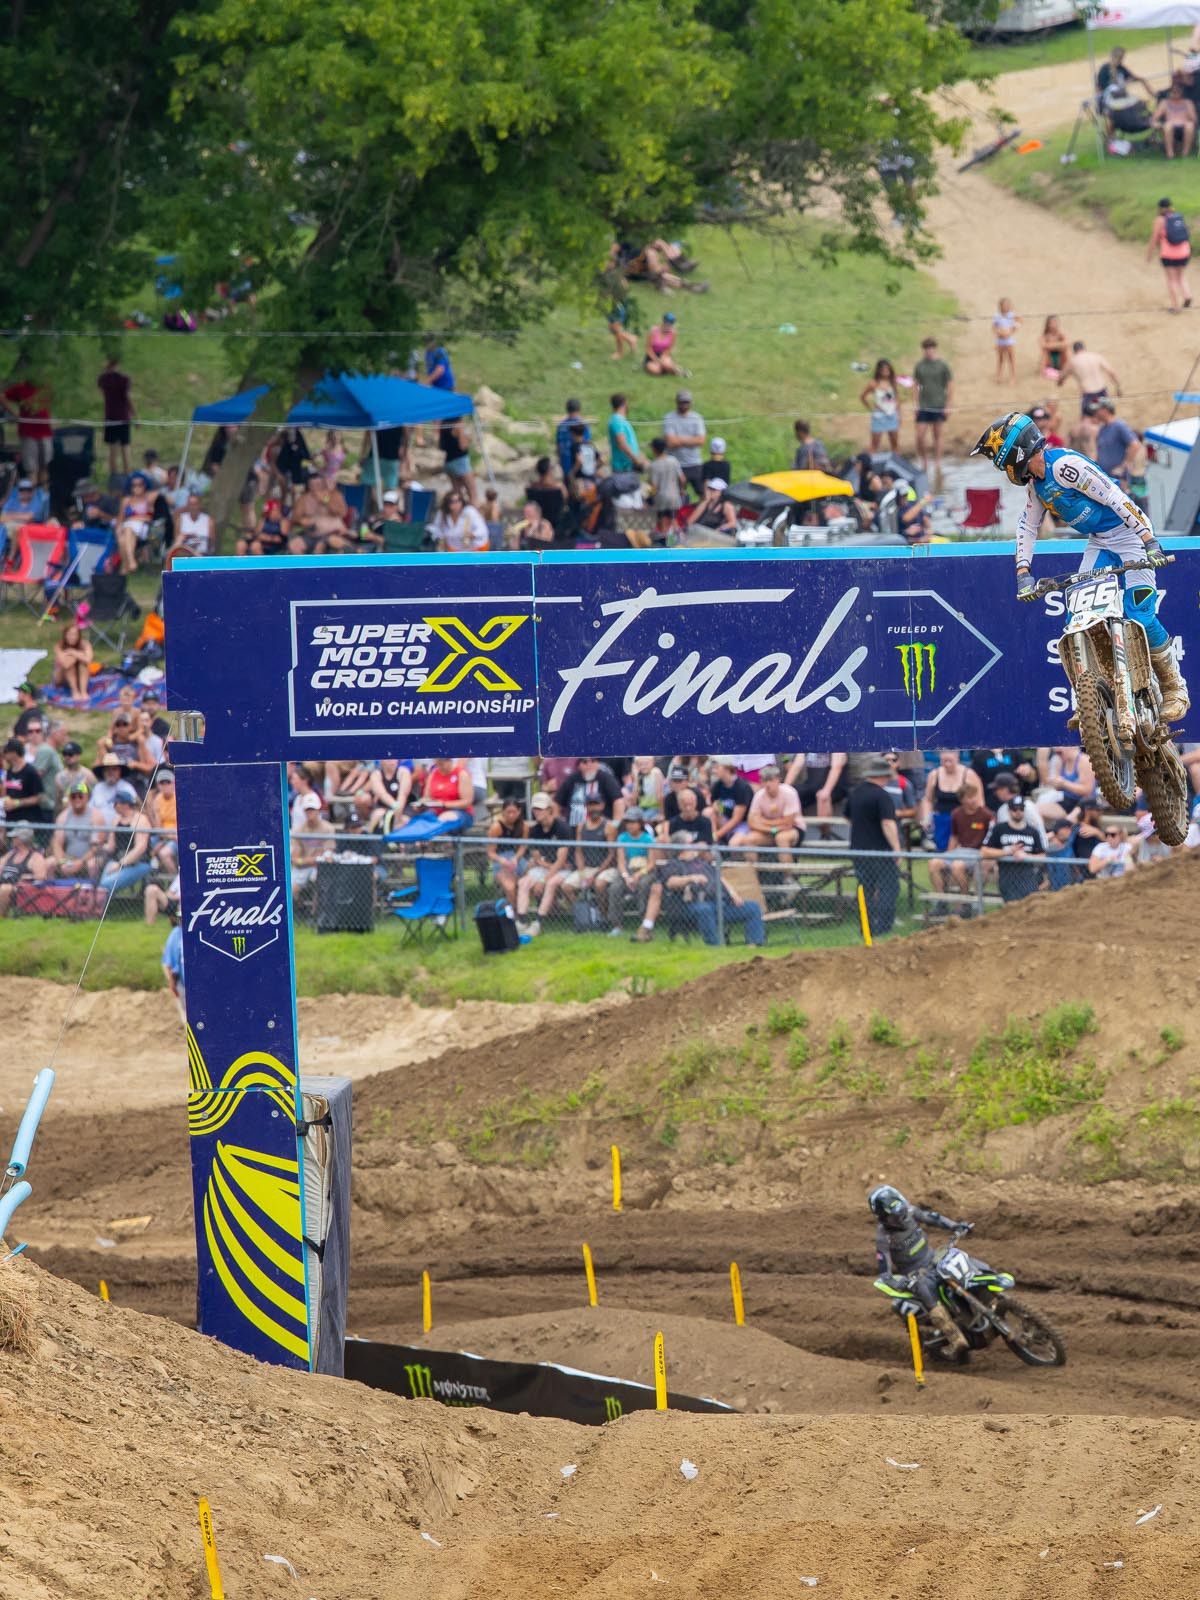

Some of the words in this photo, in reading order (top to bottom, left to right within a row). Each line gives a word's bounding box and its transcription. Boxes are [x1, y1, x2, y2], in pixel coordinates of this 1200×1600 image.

[1068, 582, 1117, 613] 166
[310, 623, 433, 645] SUPER
[887, 625, 927, 635] FUELED
[930, 624, 944, 634] BY
[318, 645, 427, 667] MOTO
[548, 586, 869, 733] Finals
[310, 667, 430, 689] CROSS
[315, 701, 383, 717] WORLD
[387, 699, 535, 716] CHAMPIONSHIP
[188, 886, 283, 932] Finals
[946, 1253, 970, 1280] 17
[433, 1379, 491, 1401] MONSTER
